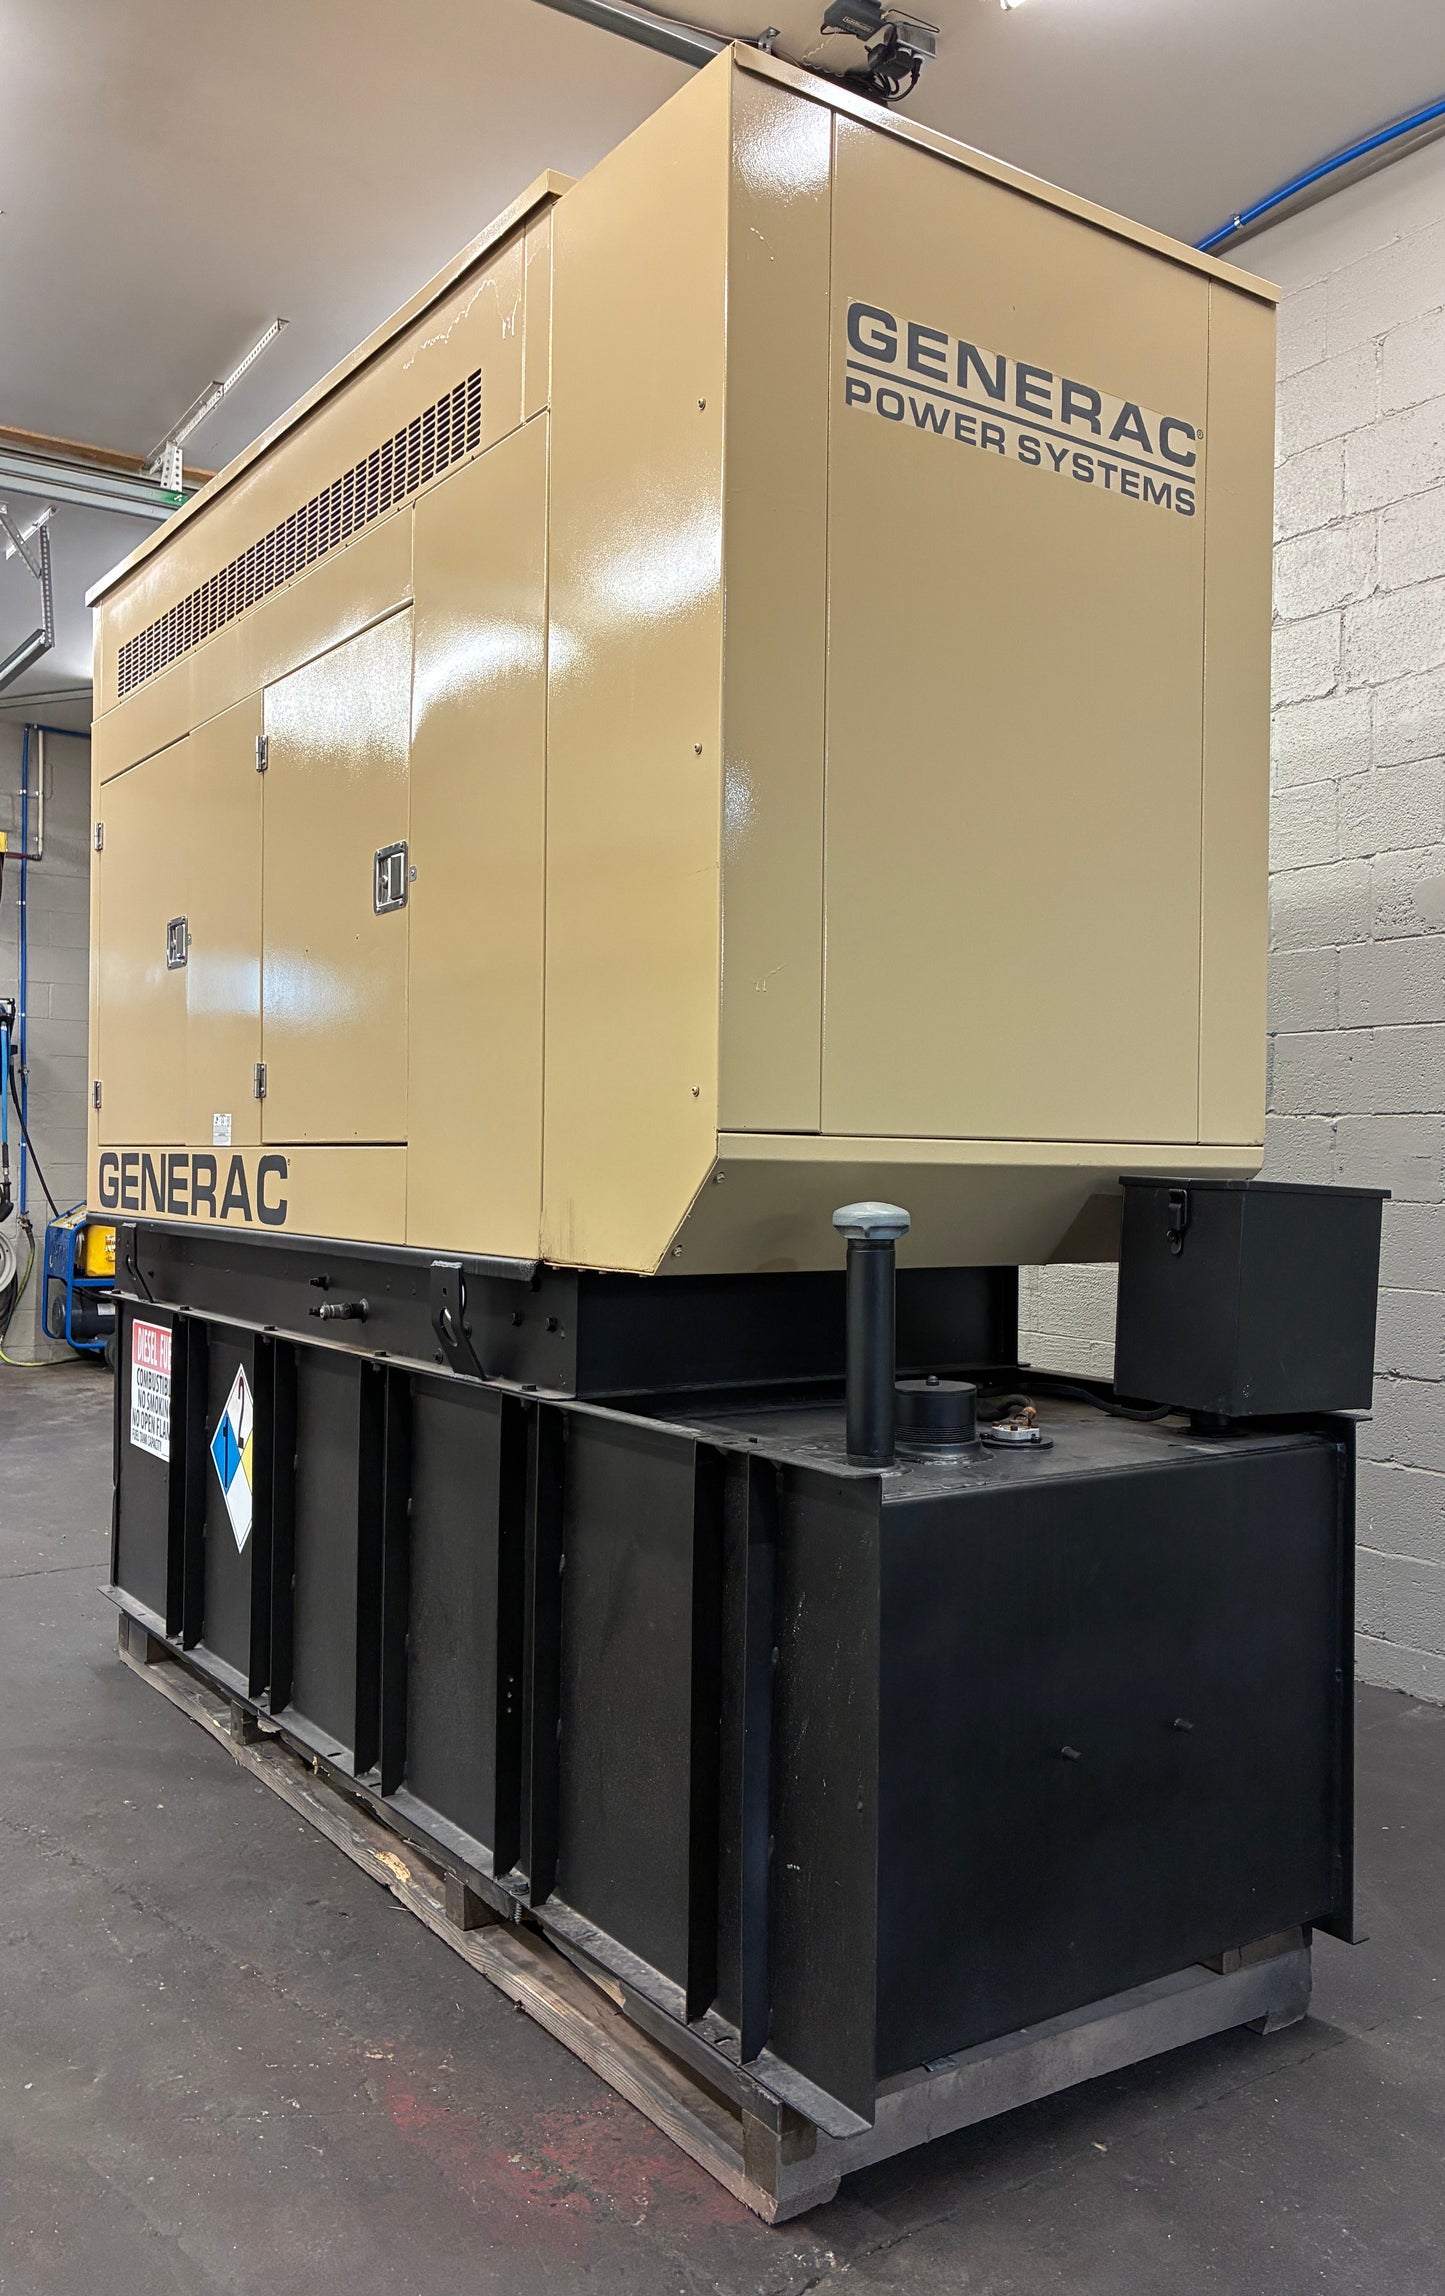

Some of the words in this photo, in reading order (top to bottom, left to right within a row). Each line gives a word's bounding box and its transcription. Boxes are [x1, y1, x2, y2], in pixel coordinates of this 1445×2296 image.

[845, 376, 1006, 456] POWER
[1017, 434, 1196, 517] SYSTEMS
[98, 1152, 289, 1226] GENERAC
[137, 1327, 158, 1366] DIESEL
[132, 1407, 140, 1427] NO
[140, 1410, 156, 1435] OPEN
[137, 1388, 146, 1409] NO
[146, 1391, 170, 1419] SMOKIN
[237, 1376, 245, 1449] 2
[222, 1416, 229, 1488] 1
